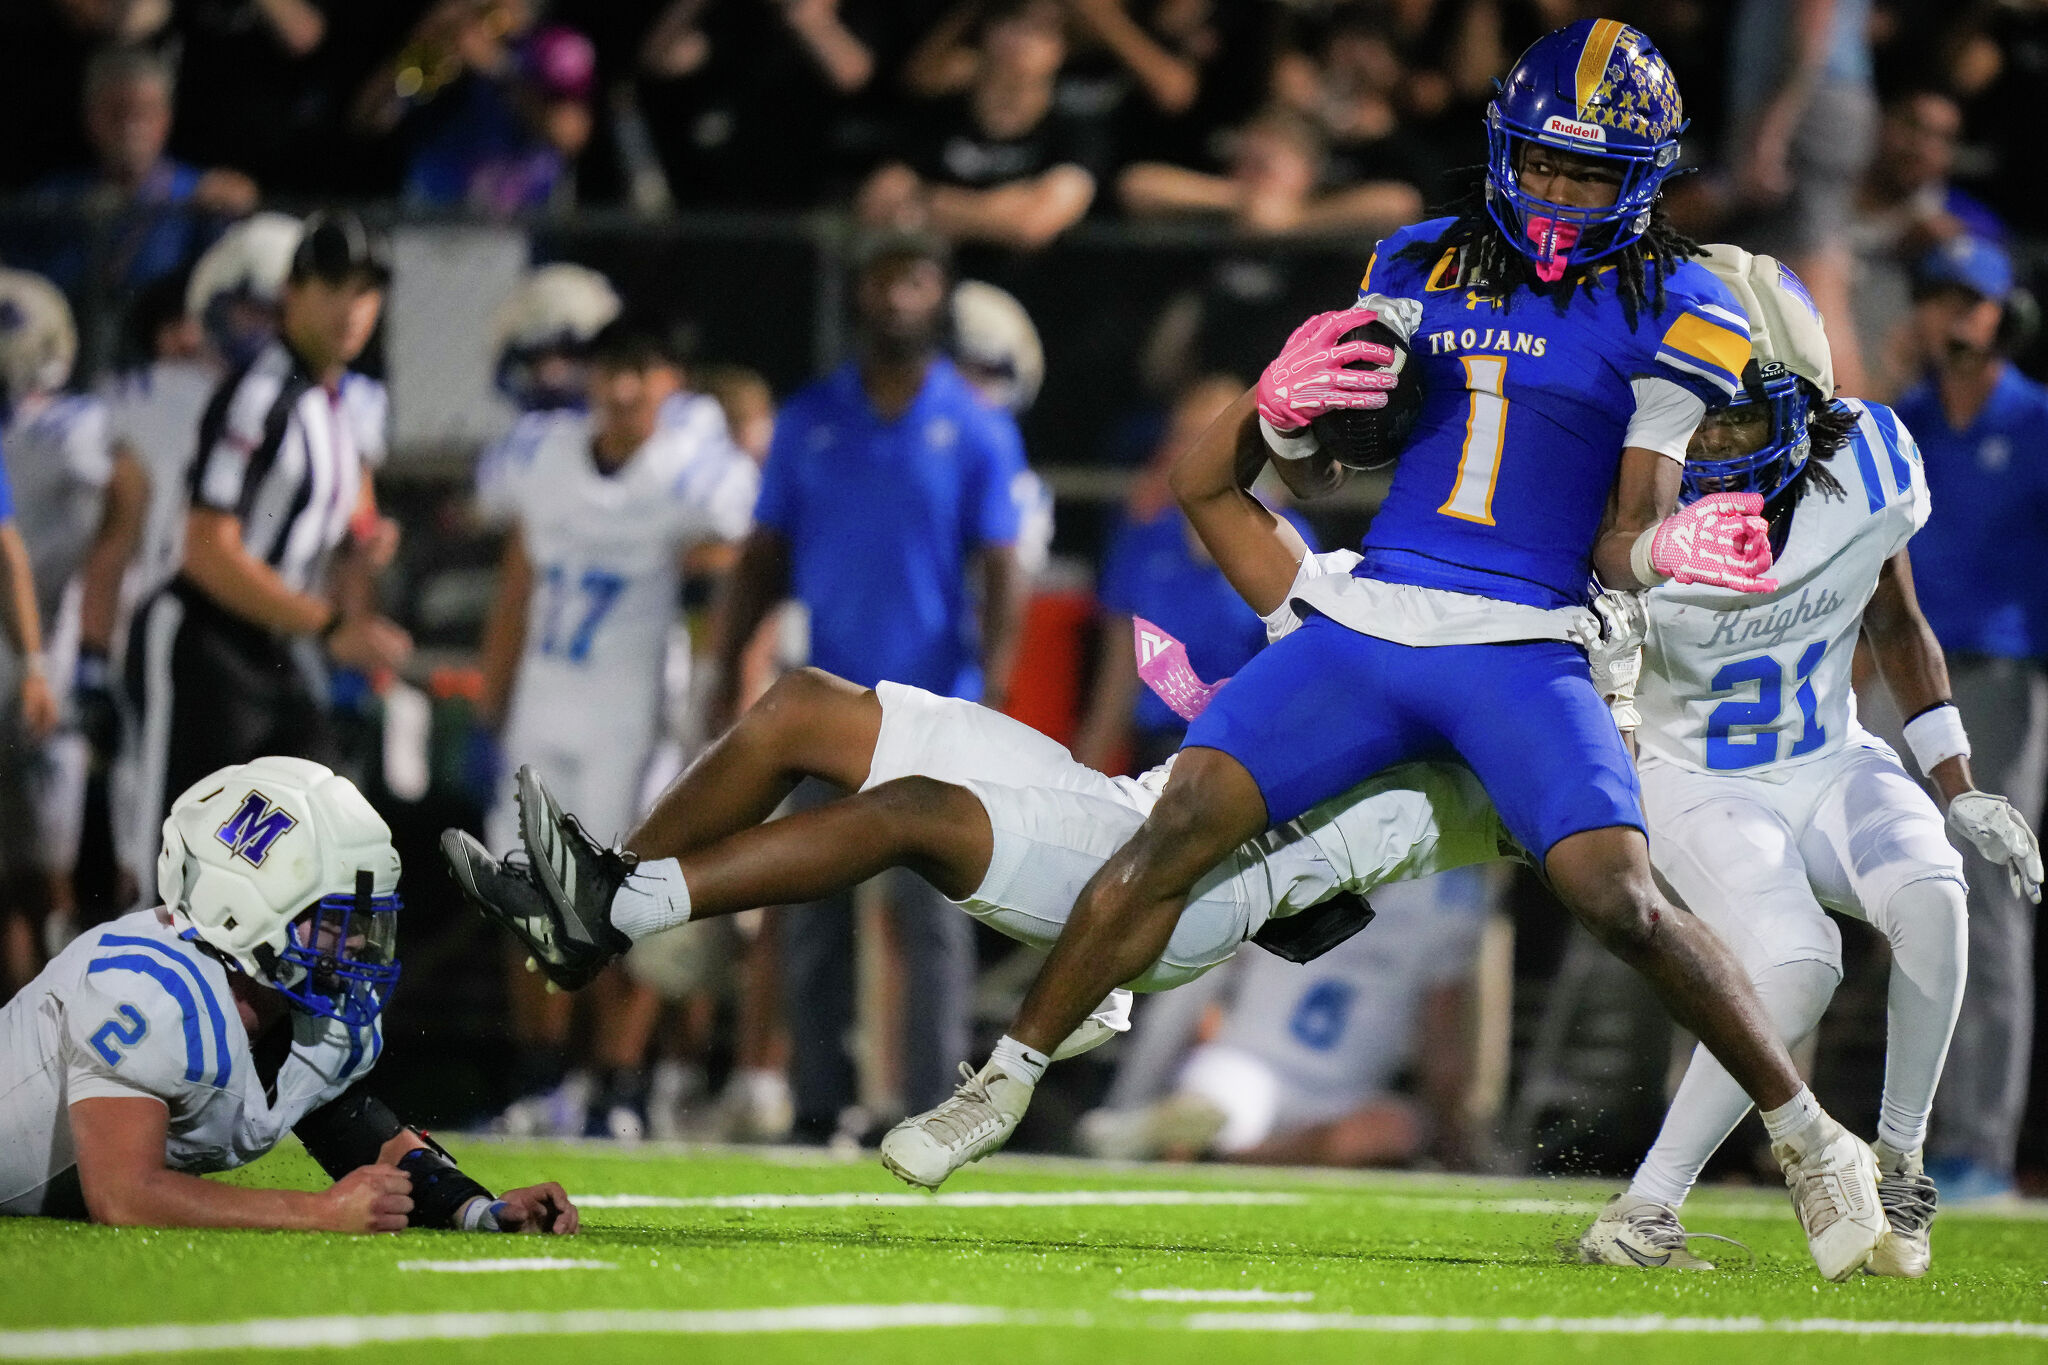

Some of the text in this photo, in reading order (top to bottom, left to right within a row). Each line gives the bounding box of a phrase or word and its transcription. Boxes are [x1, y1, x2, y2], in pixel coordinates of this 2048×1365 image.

[1551, 120, 1599, 139] Riddell
[1428, 328, 1548, 357] TROJANS
[1436, 354, 1510, 527] 1
[540, 563, 630, 666] 17
[1697, 588, 1845, 648] Knights
[1706, 638, 1829, 771] 21
[214, 789, 299, 869] M
[85, 1002, 151, 1072] 2
